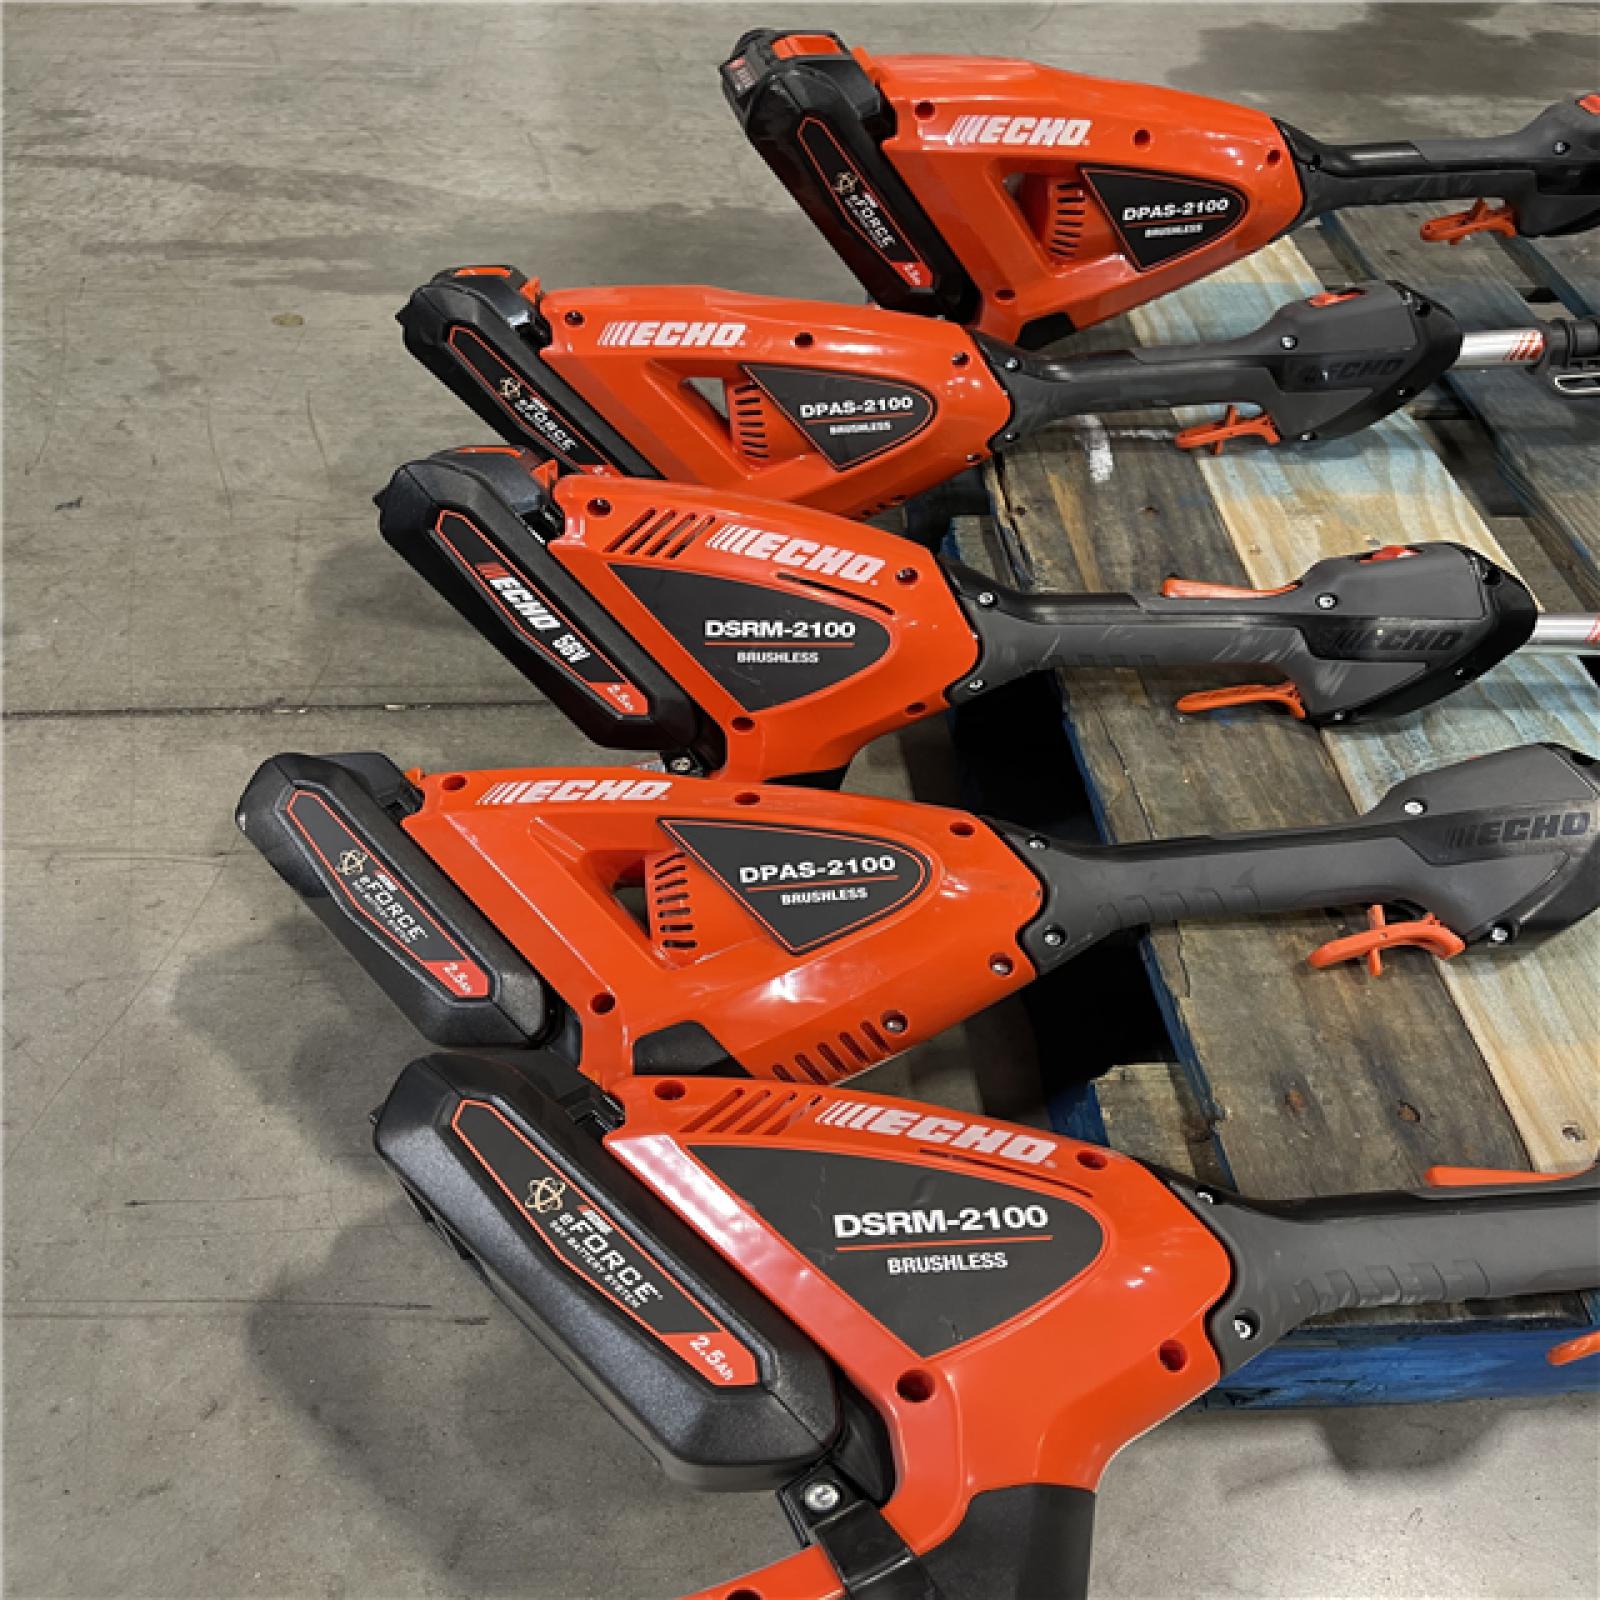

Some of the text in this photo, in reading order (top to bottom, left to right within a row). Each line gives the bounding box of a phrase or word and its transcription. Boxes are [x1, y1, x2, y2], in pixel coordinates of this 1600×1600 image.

[979, 115, 1092, 145] ECHO
[1123, 197, 1230, 220] DPAS-2100
[629, 320, 746, 347] ECHO
[800, 396, 913, 418] DPAS-2100
[744, 531, 886, 583] ECHO
[489, 576, 561, 631] ECHO
[704, 620, 856, 638] DSRM-2100
[736, 651, 820, 664] BRUSHLESS
[516, 778, 673, 804] ECHO
[1477, 811, 1591, 845] ECHO
[738, 854, 896, 884] DPAS-2100
[780, 887, 868, 906] BRUSHLESS
[868, 1108, 1057, 1165] ECHO
[832, 1204, 1050, 1239] DSRM-2100
[887, 1251, 1009, 1276] BRUSHLESS
